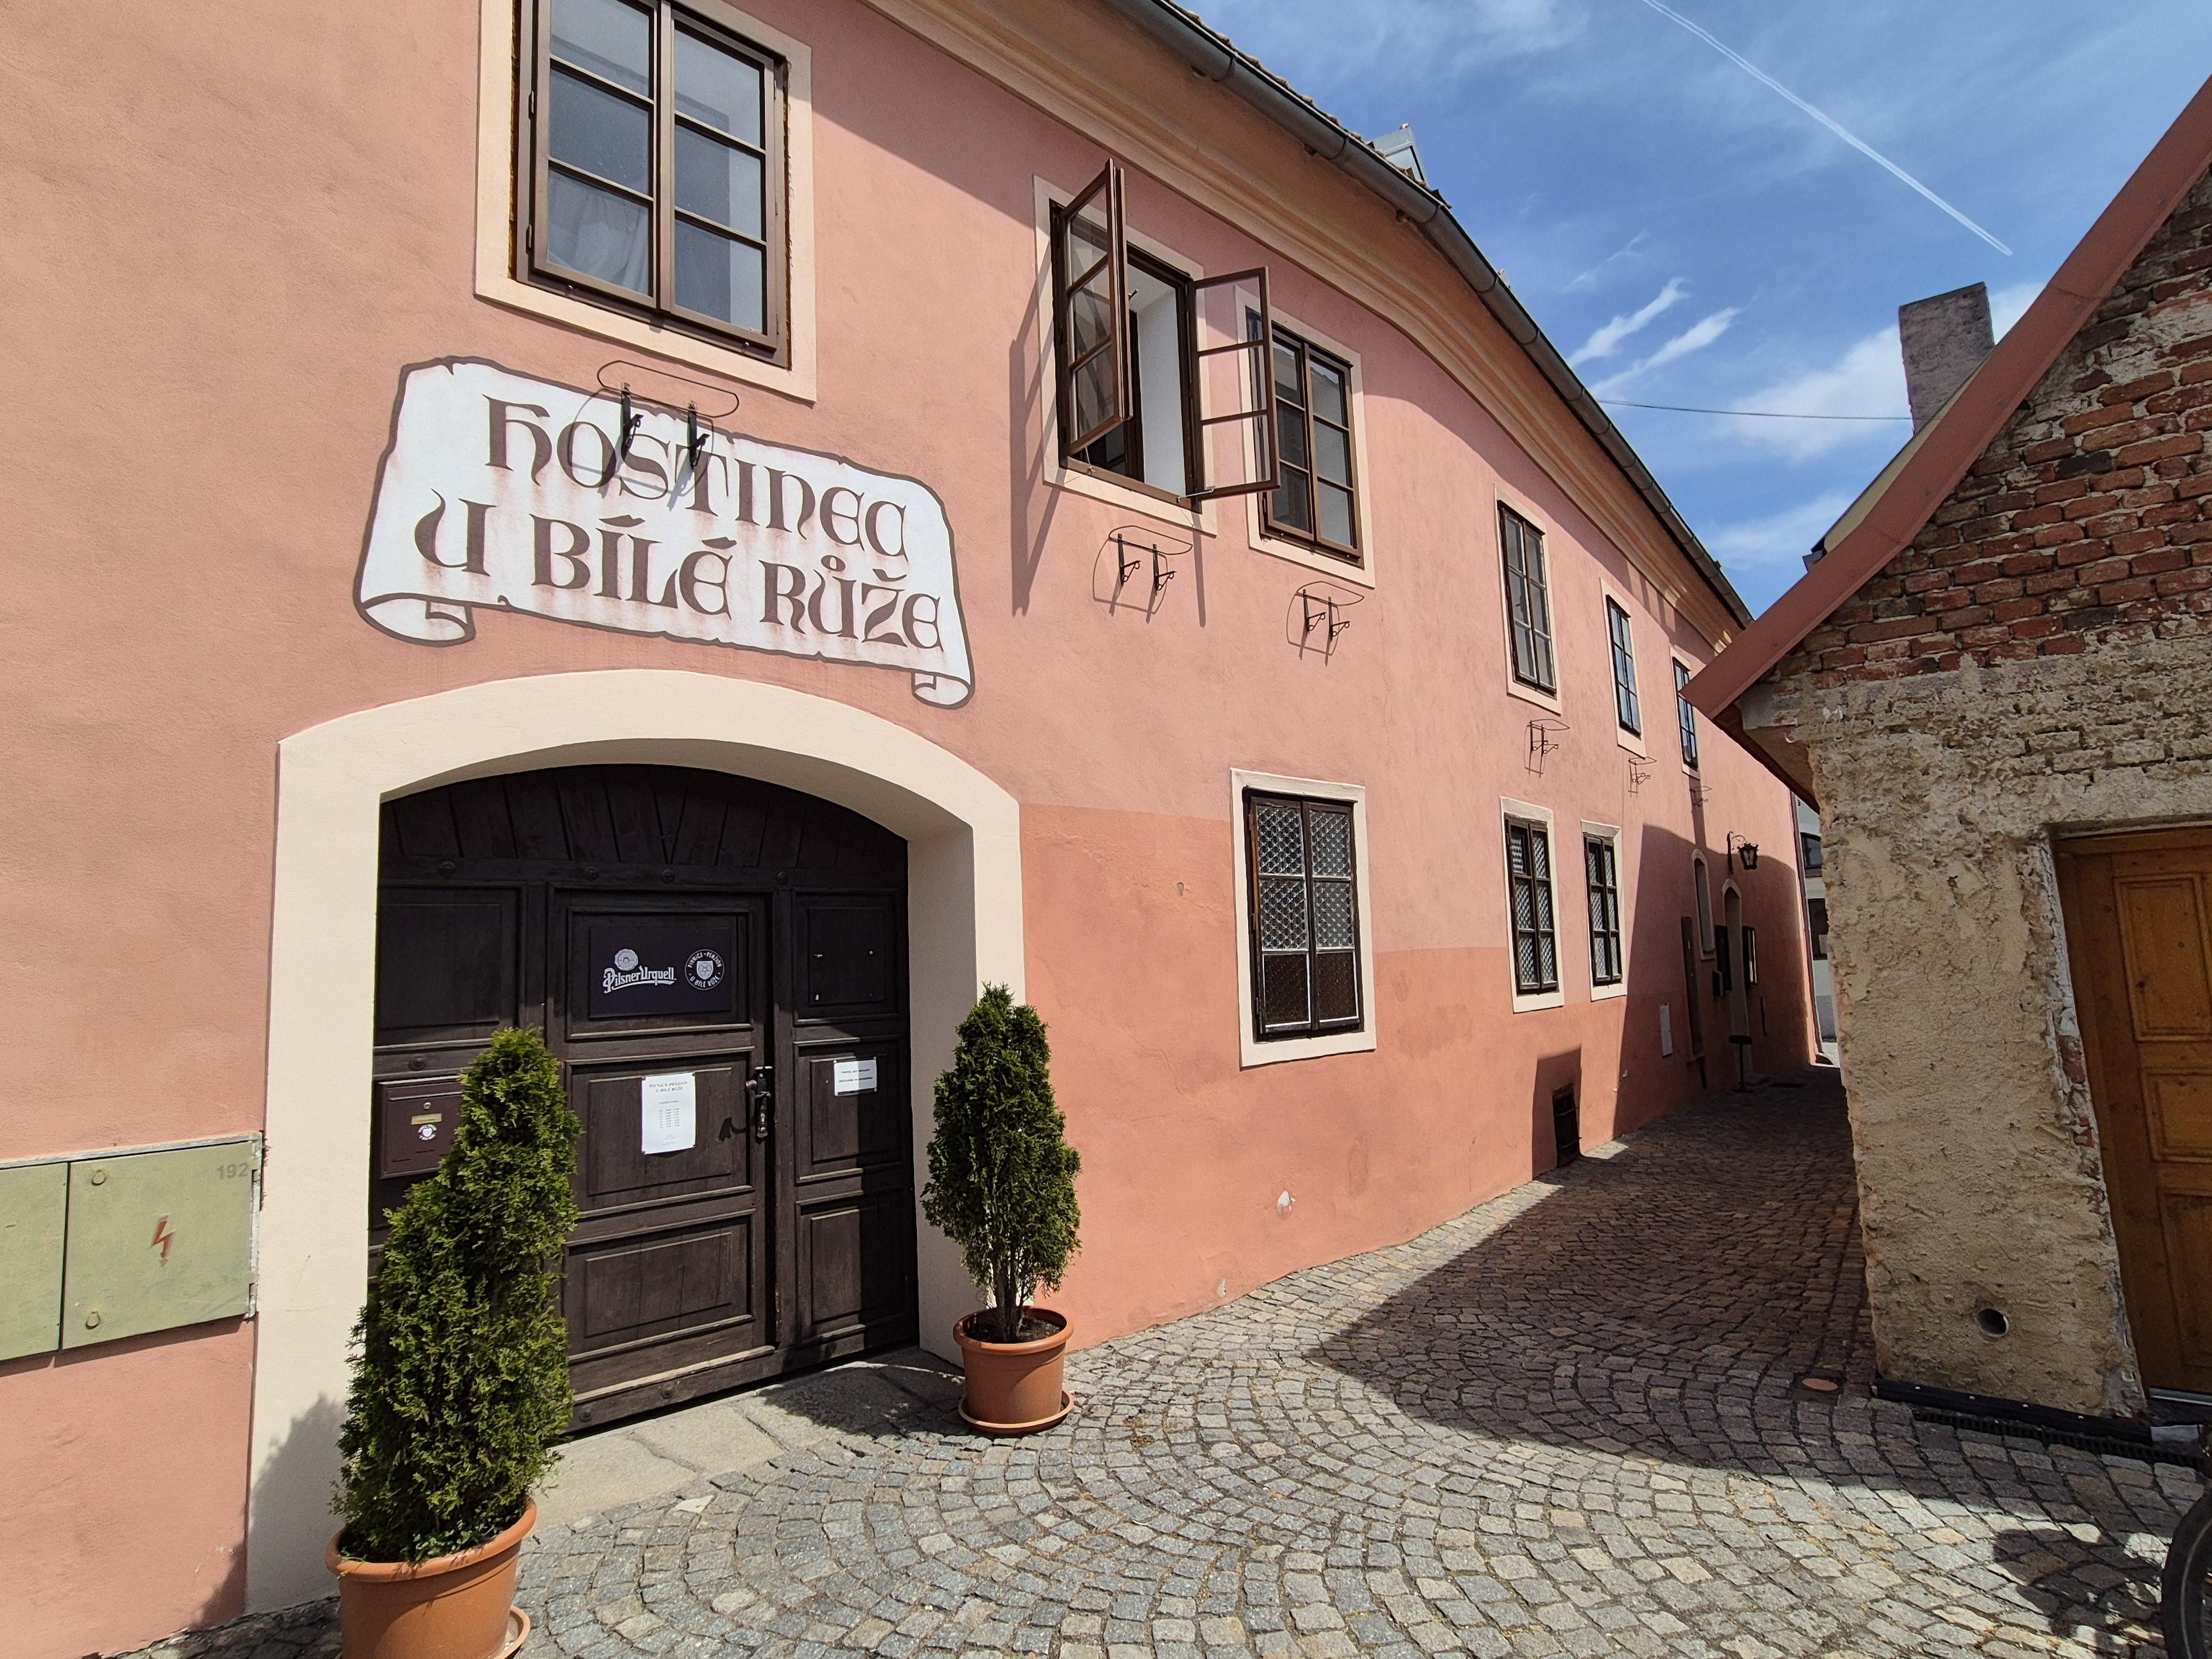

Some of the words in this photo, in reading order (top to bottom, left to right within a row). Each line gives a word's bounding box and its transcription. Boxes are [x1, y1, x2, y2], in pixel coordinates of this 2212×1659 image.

[482, 394, 907, 561] HOSTINEC
[415, 489, 496, 576] U
[530, 514, 737, 620] BÍLÉ
[758, 555, 945, 651] RŮŽE
[603, 968, 641, 993] Pilsner
[639, 966, 675, 985] Urquell
[216, 1162, 248, 1180] 192
